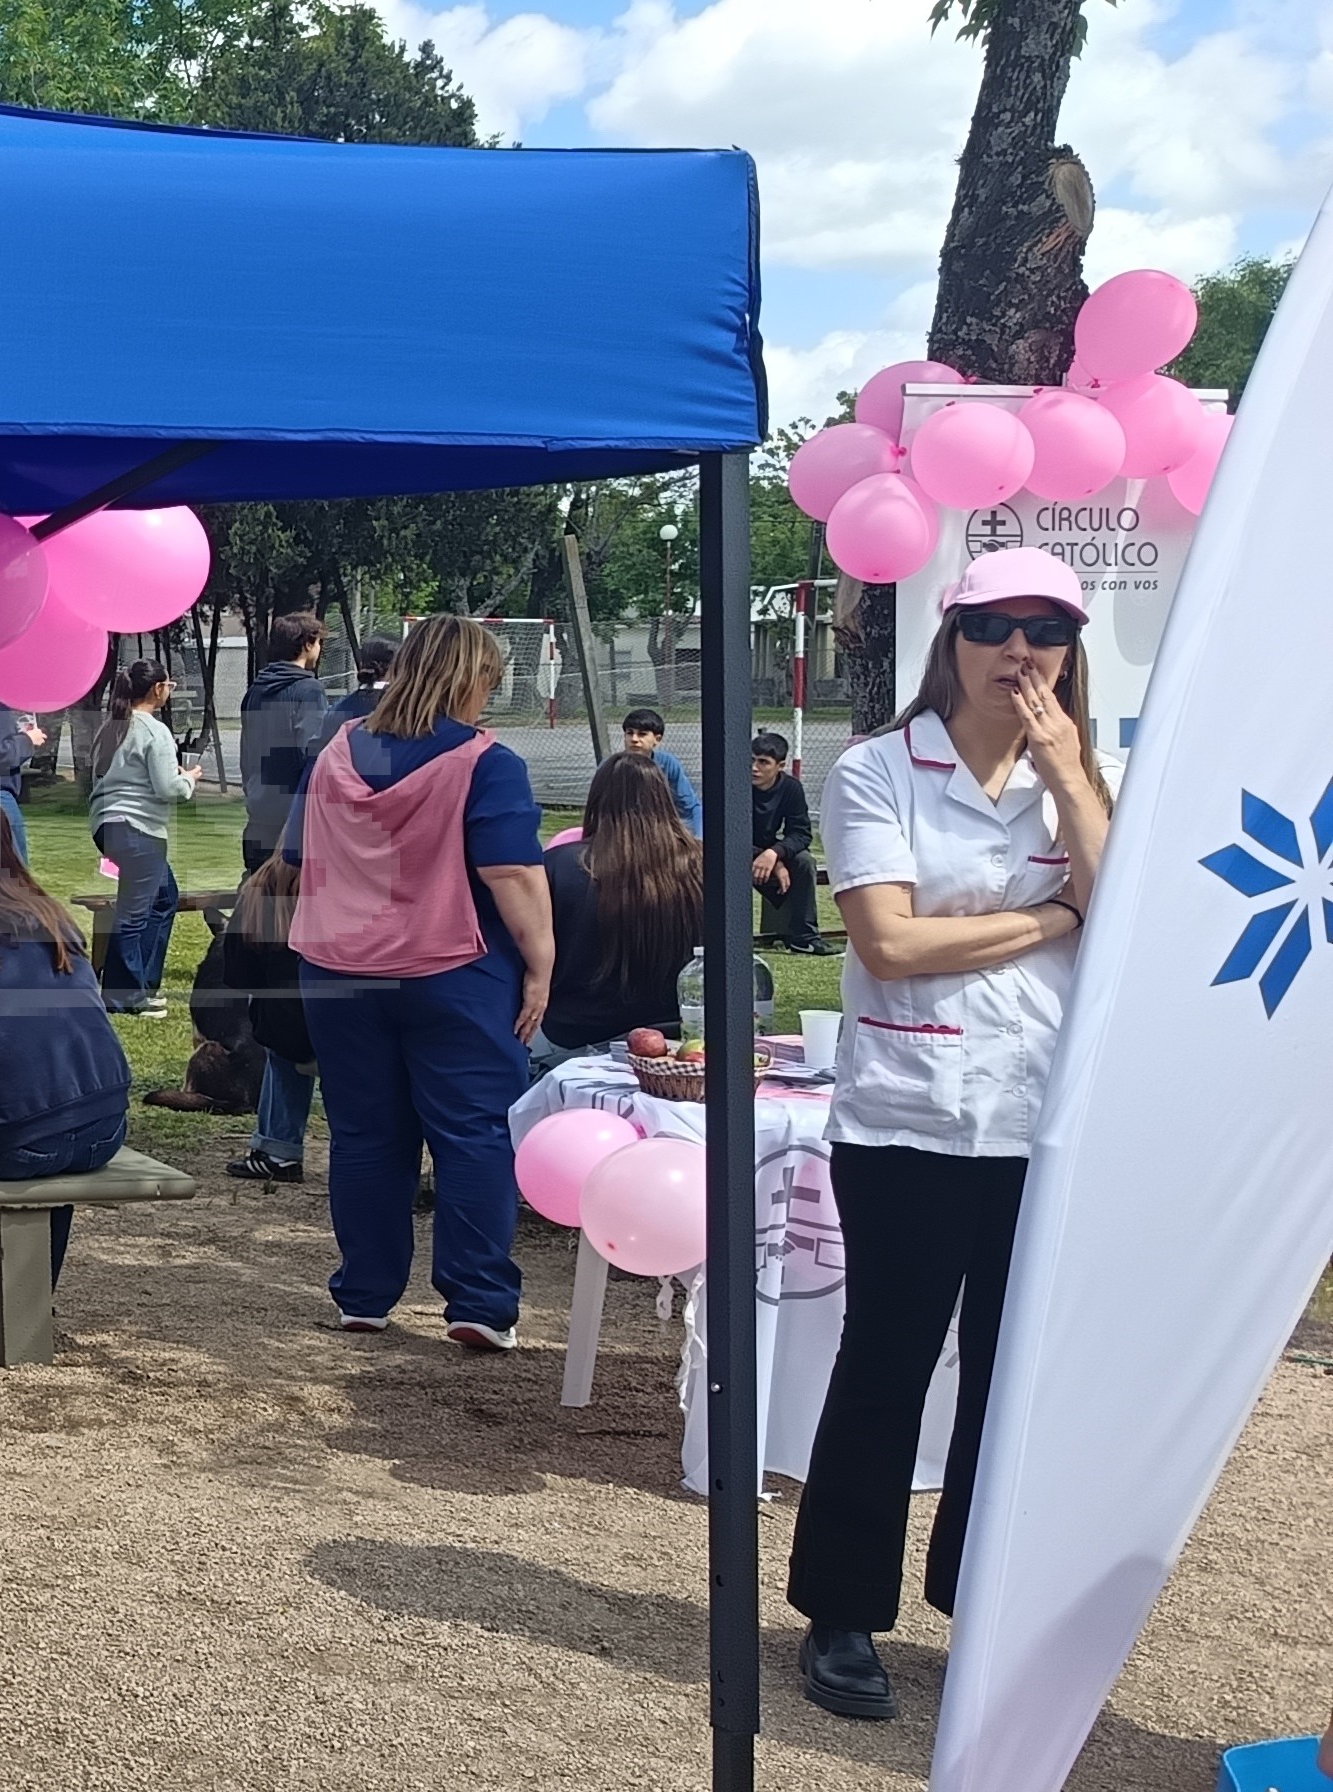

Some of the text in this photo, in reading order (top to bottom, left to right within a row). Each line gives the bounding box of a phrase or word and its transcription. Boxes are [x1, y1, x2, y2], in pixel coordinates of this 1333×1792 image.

[1036, 501, 1140, 532] CÍRCULO
[1101, 580, 1128, 591] con
[1134, 579, 1159, 591] vos
